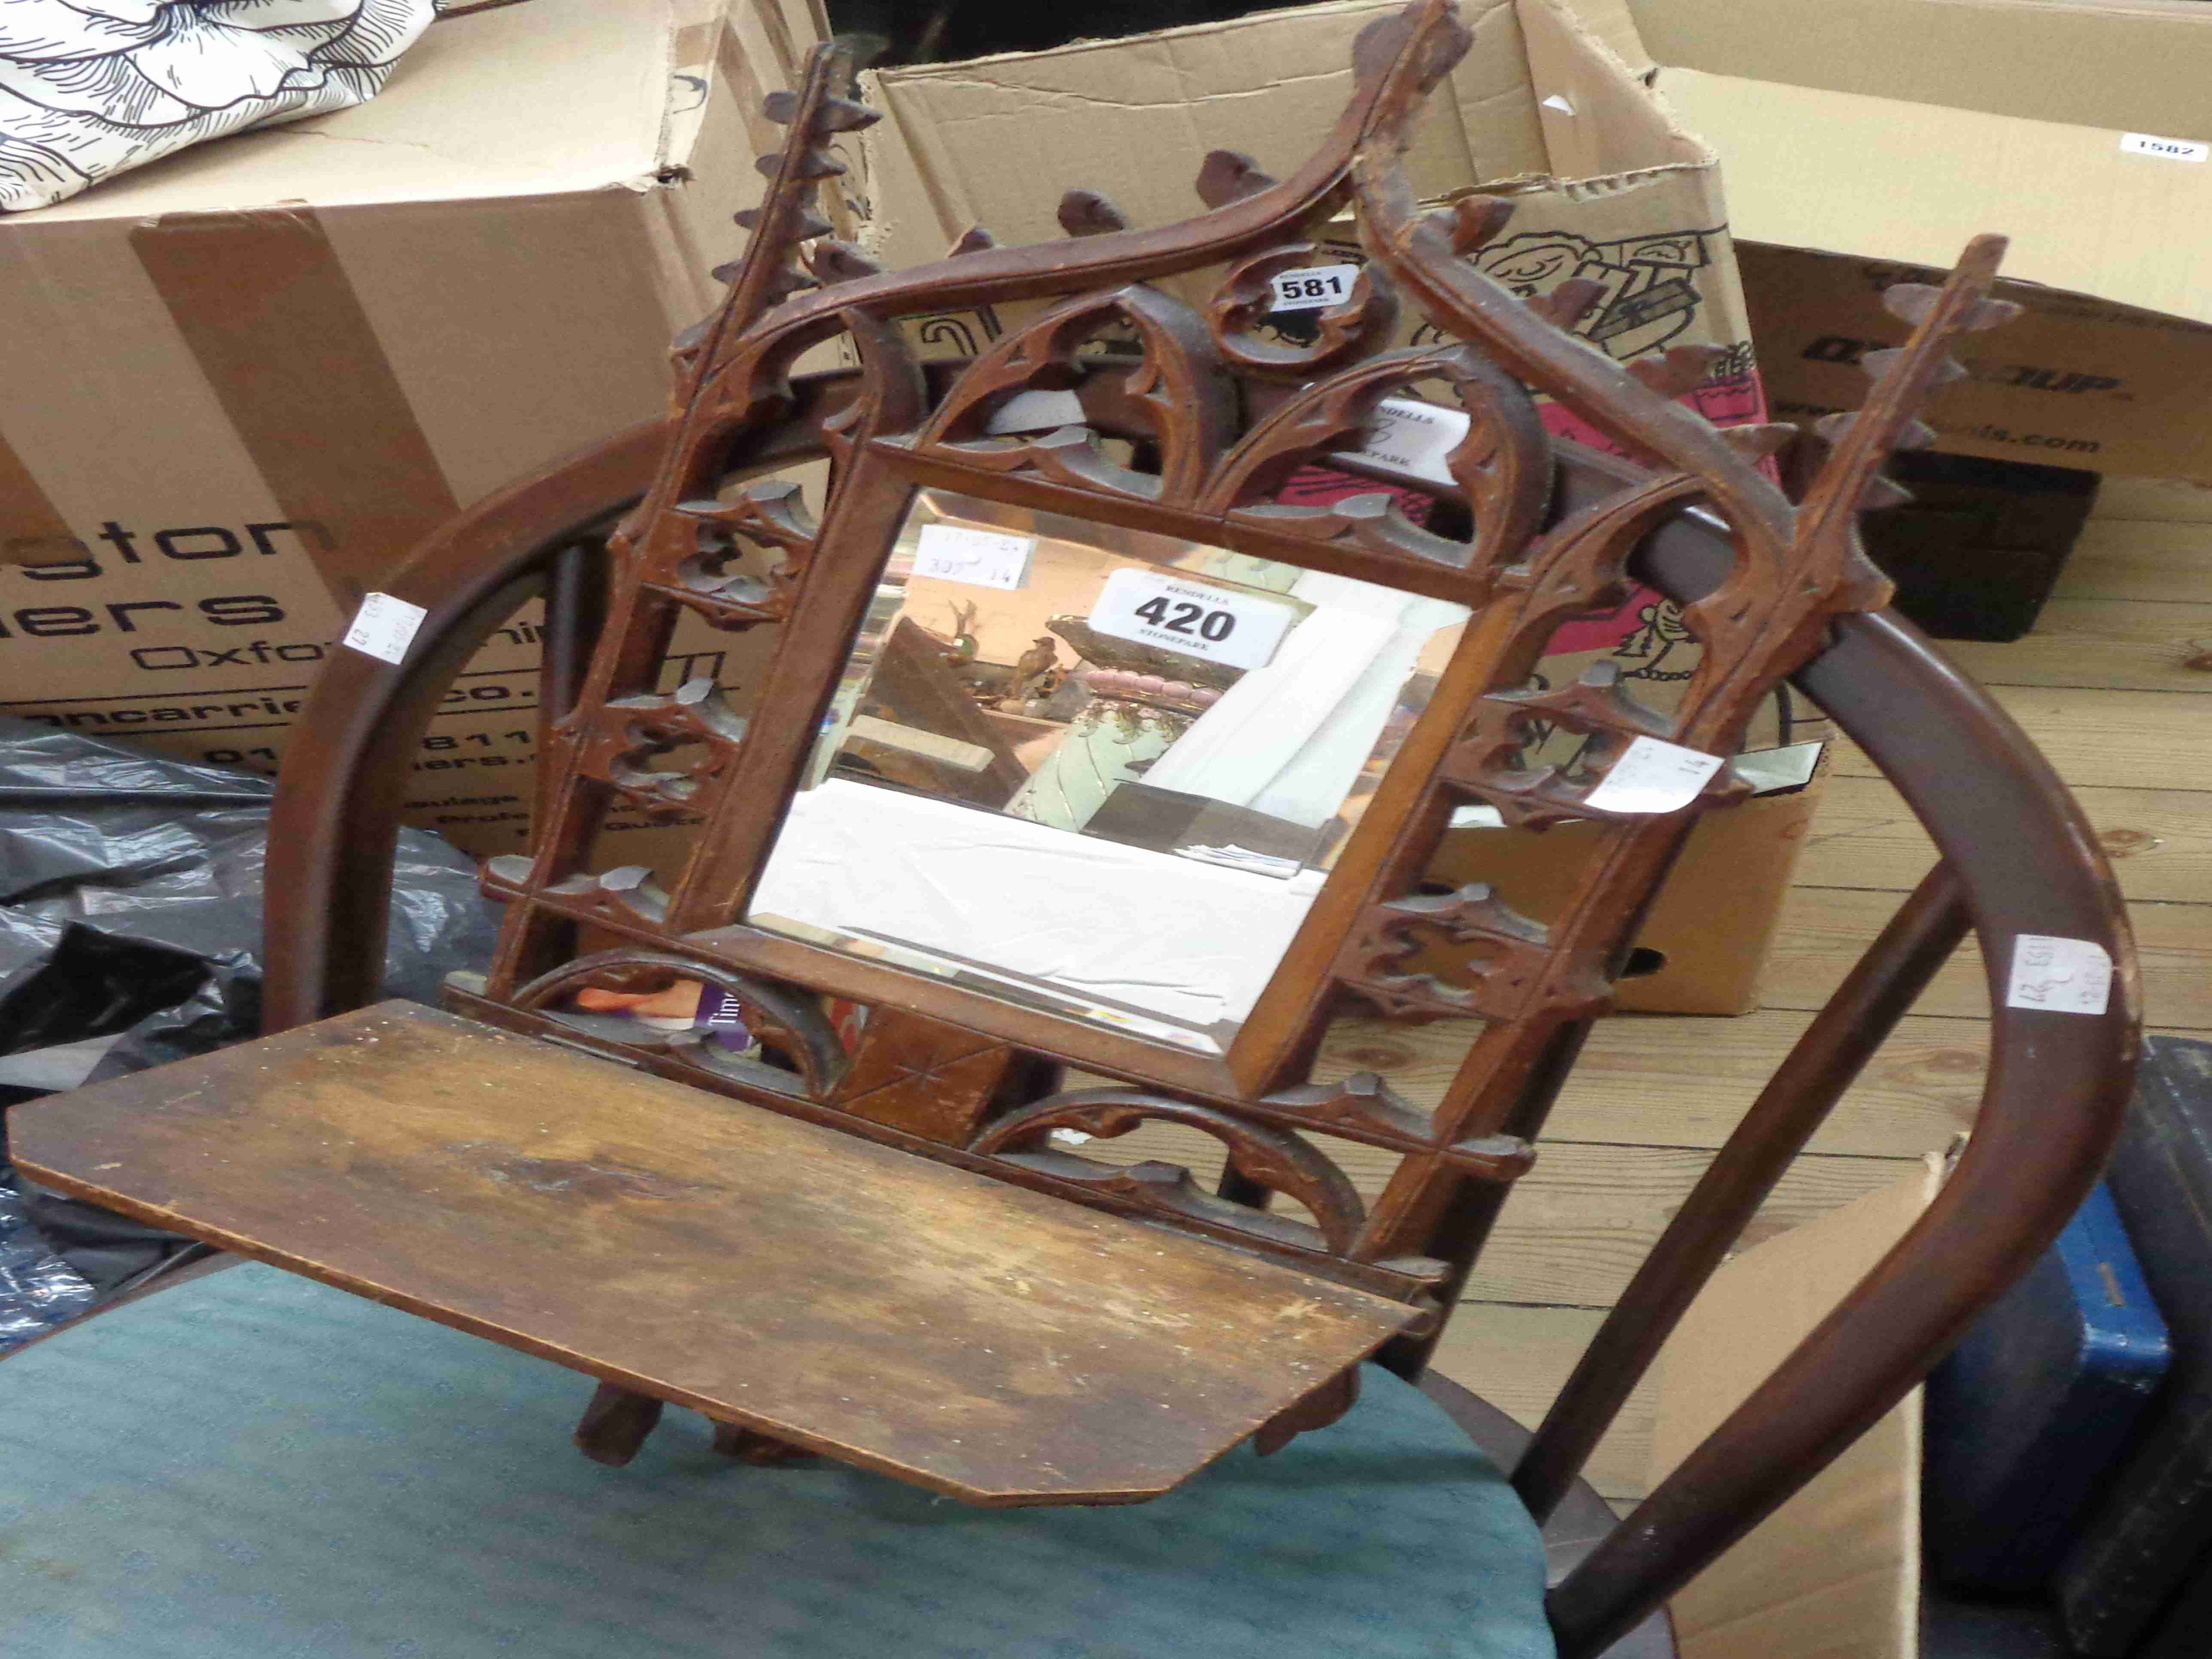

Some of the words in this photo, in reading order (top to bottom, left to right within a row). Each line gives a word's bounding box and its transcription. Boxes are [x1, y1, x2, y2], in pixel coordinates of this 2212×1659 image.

[2140, 140, 2195, 155] 1582
[1282, 276, 1342, 299] 581
[1165, 584, 1229, 605] RENDELLS
[0, 595, 285, 638] ers
[1134, 596, 1237, 642] 420
[1138, 628, 1209, 651] STONEPARK
[130, 641, 333, 670] Oxfo
[708, 992, 741, 1026] Tim
